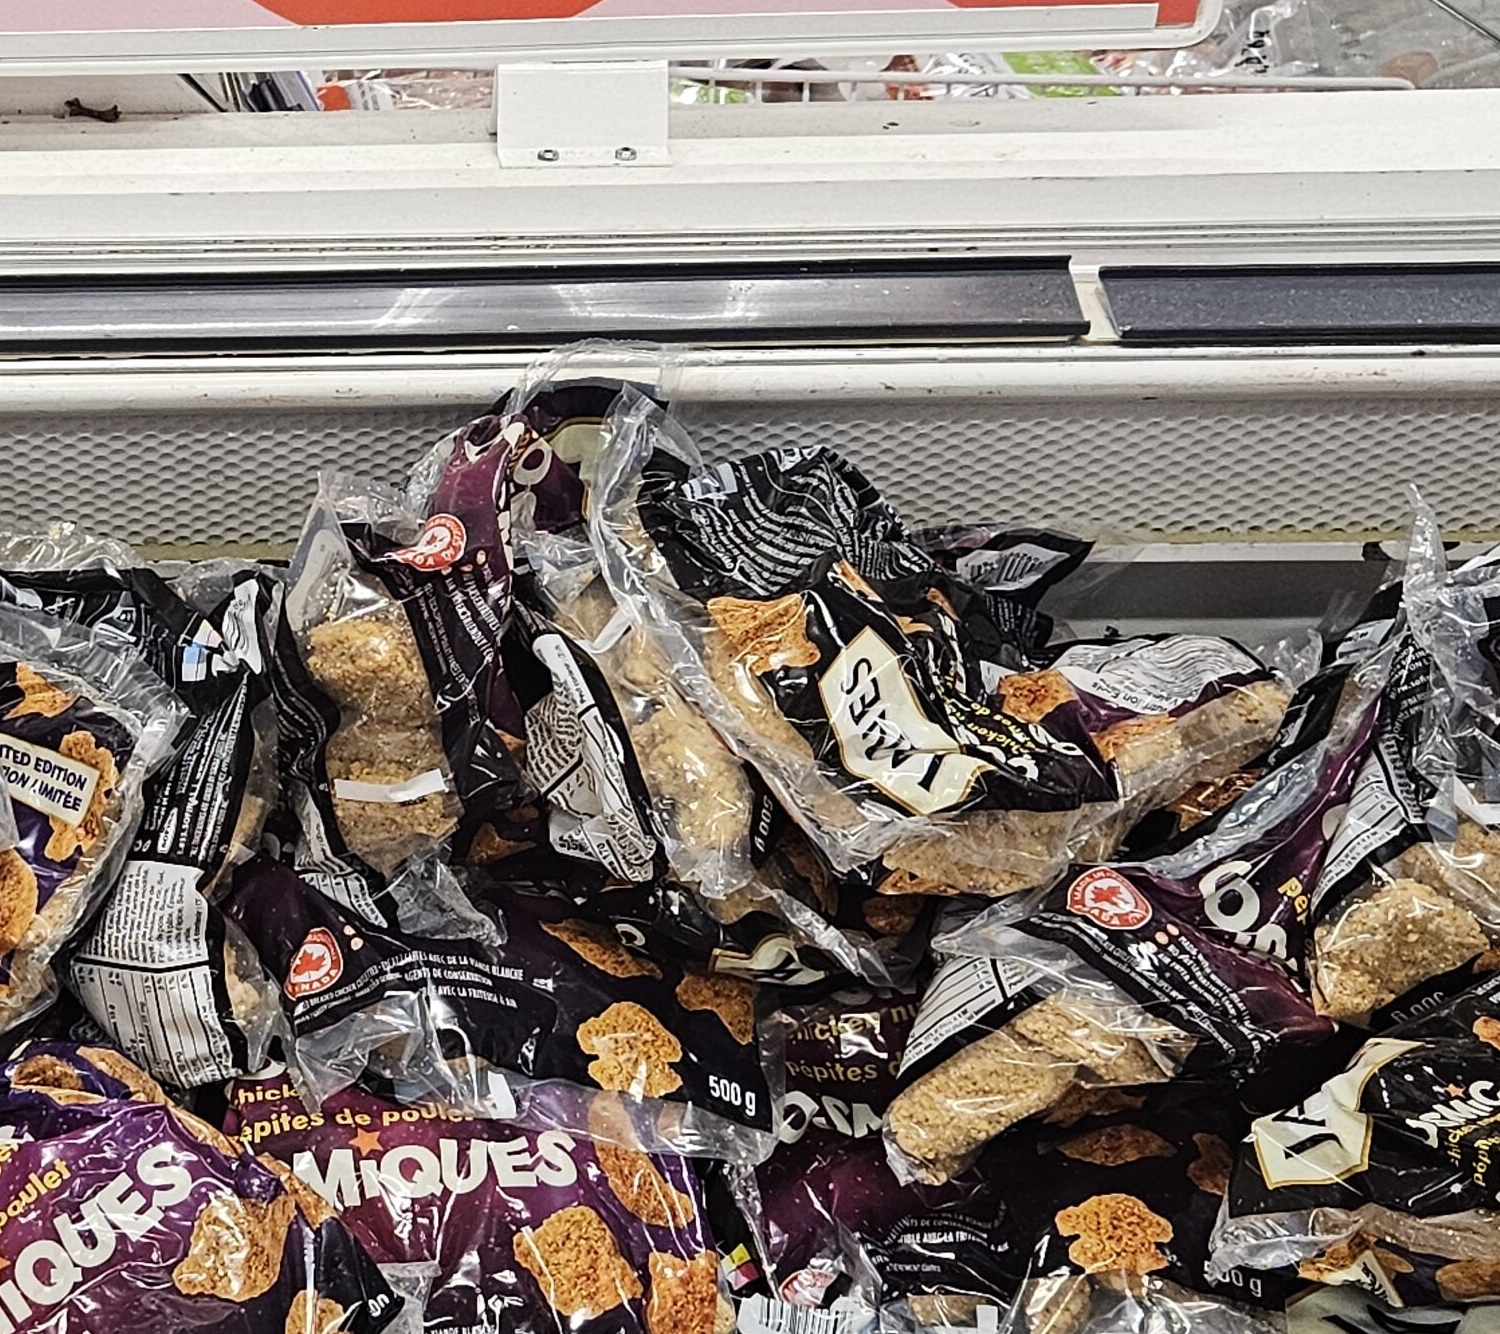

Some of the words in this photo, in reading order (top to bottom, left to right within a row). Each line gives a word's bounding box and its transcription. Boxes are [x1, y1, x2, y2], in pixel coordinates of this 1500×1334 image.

[34, 758, 87, 791] EDITION
[709, 1074, 740, 1106] 500
[743, 1090, 756, 1117] g
[240, 1109, 324, 1144] épites
[336, 1108, 371, 1126] de
[293, 1130, 578, 1207] MIQUES
